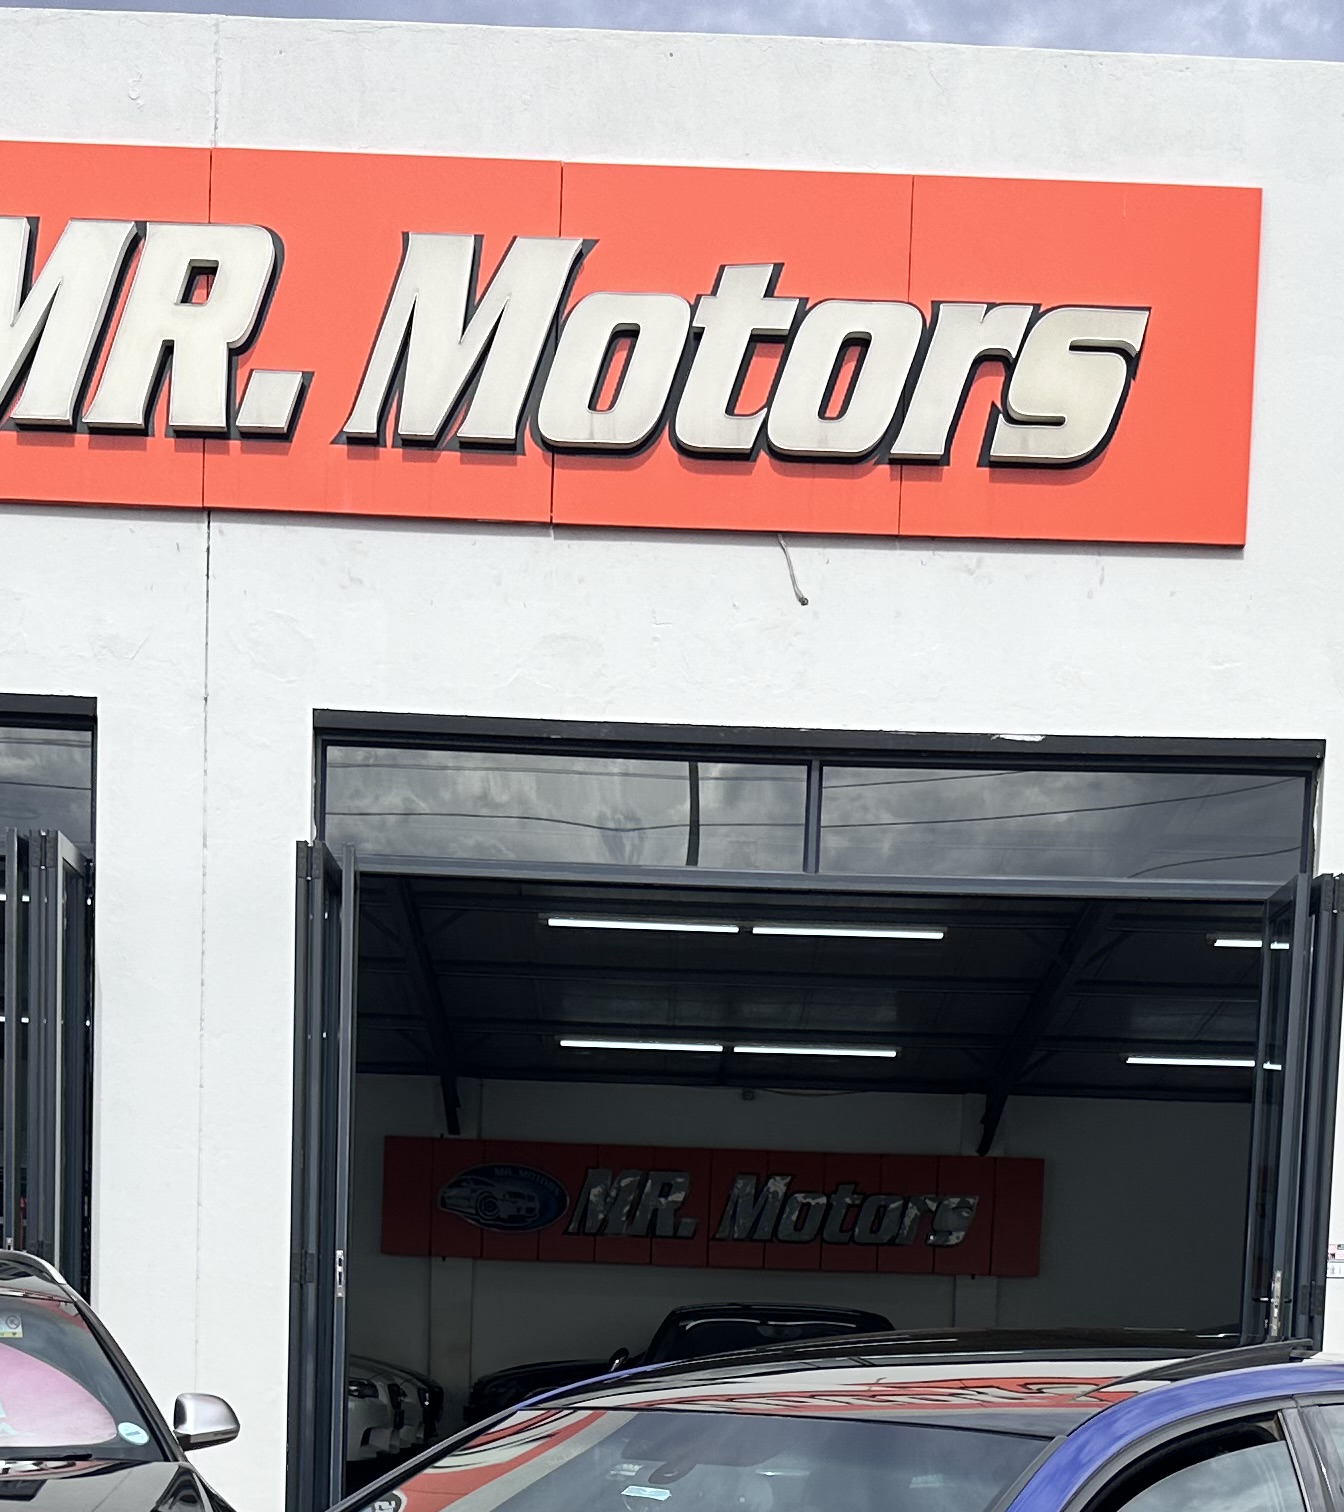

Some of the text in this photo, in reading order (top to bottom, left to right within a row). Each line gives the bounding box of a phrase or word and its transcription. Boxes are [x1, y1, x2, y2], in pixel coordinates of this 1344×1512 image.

[338, 231, 1150, 468] Motors
[566, 1167, 979, 1247] MR. Motors
